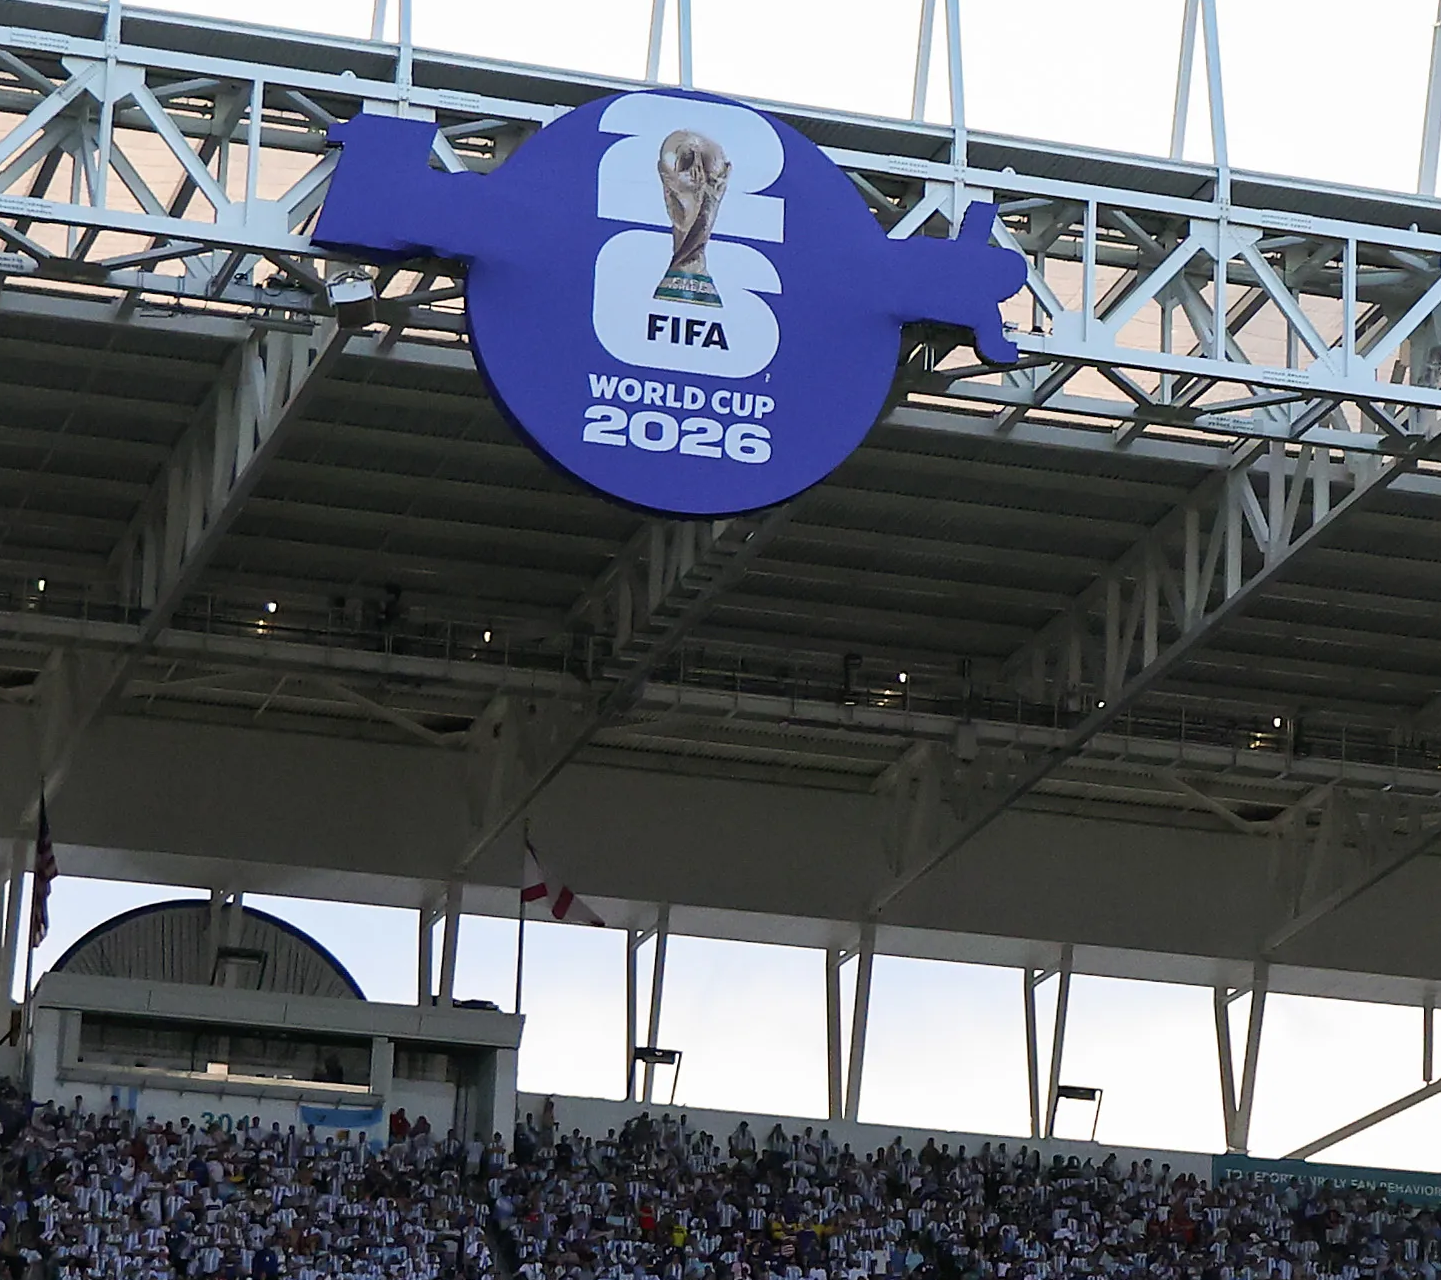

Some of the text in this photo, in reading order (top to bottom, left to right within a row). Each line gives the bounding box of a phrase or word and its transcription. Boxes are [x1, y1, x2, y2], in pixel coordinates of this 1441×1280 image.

[646, 313, 729, 351] FIFA
[588, 373, 776, 419] WORLD CUP
[582, 405, 773, 464] 2026
